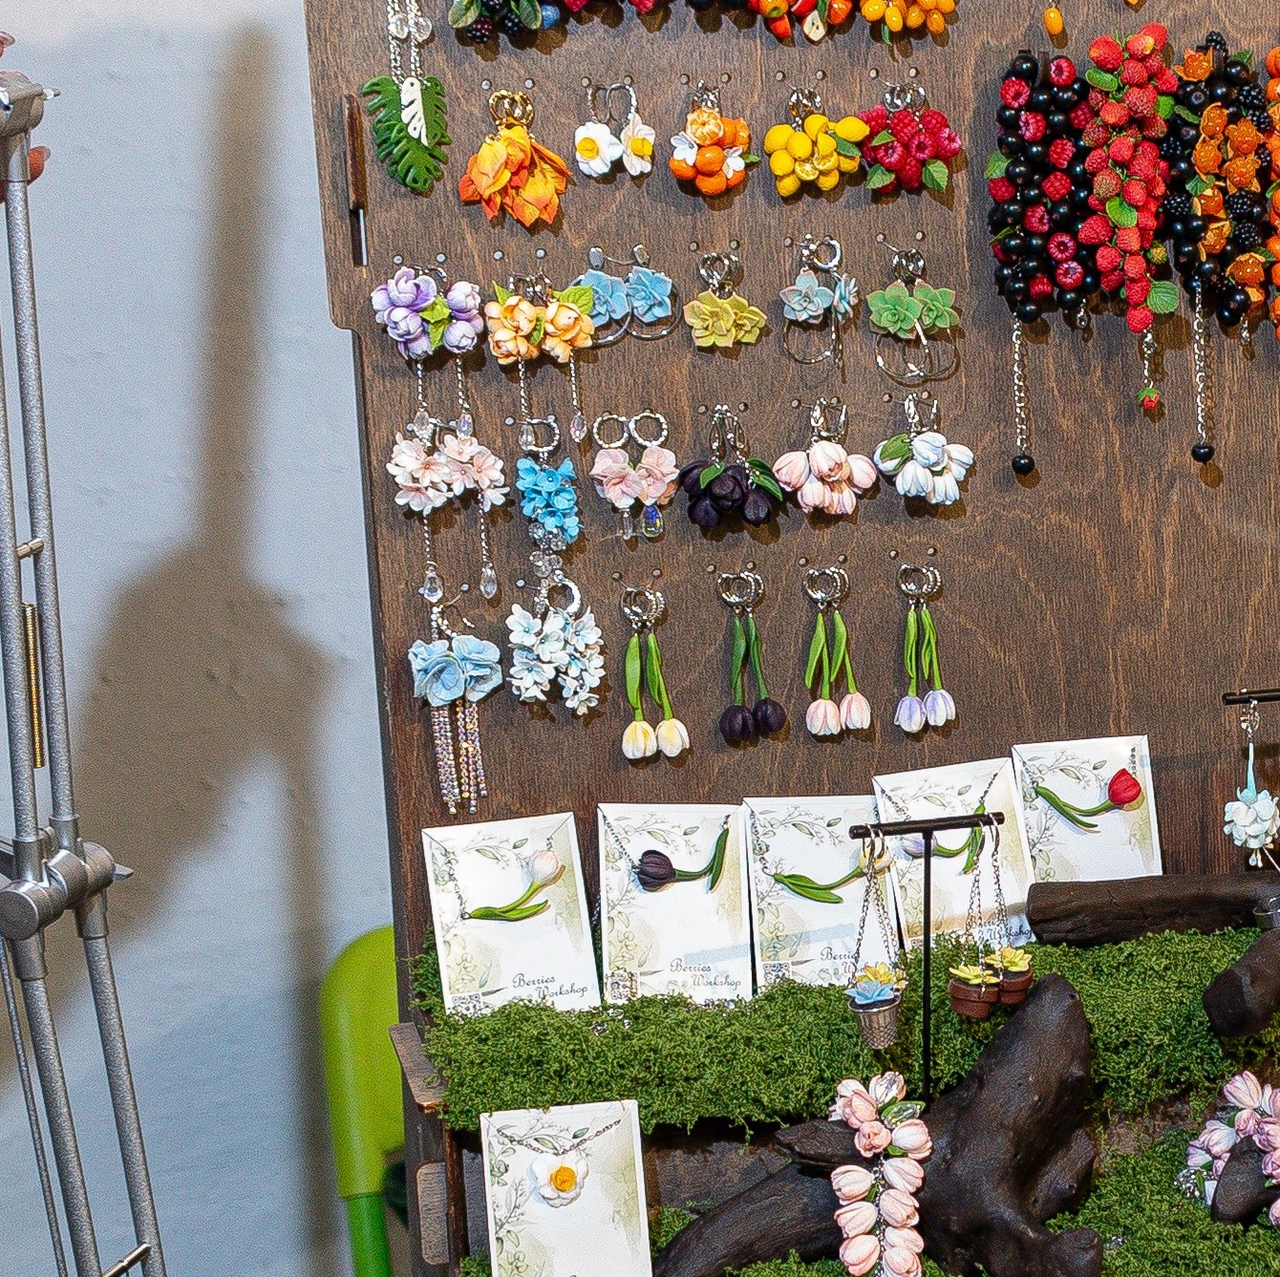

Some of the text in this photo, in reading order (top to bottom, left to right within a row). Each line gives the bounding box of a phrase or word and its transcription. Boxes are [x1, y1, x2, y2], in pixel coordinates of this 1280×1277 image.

[670, 957, 712, 973] Berries
[512, 972, 556, 989] Berries
[691, 973, 741, 991] Workshop
[535, 982, 588, 998] Workshop
